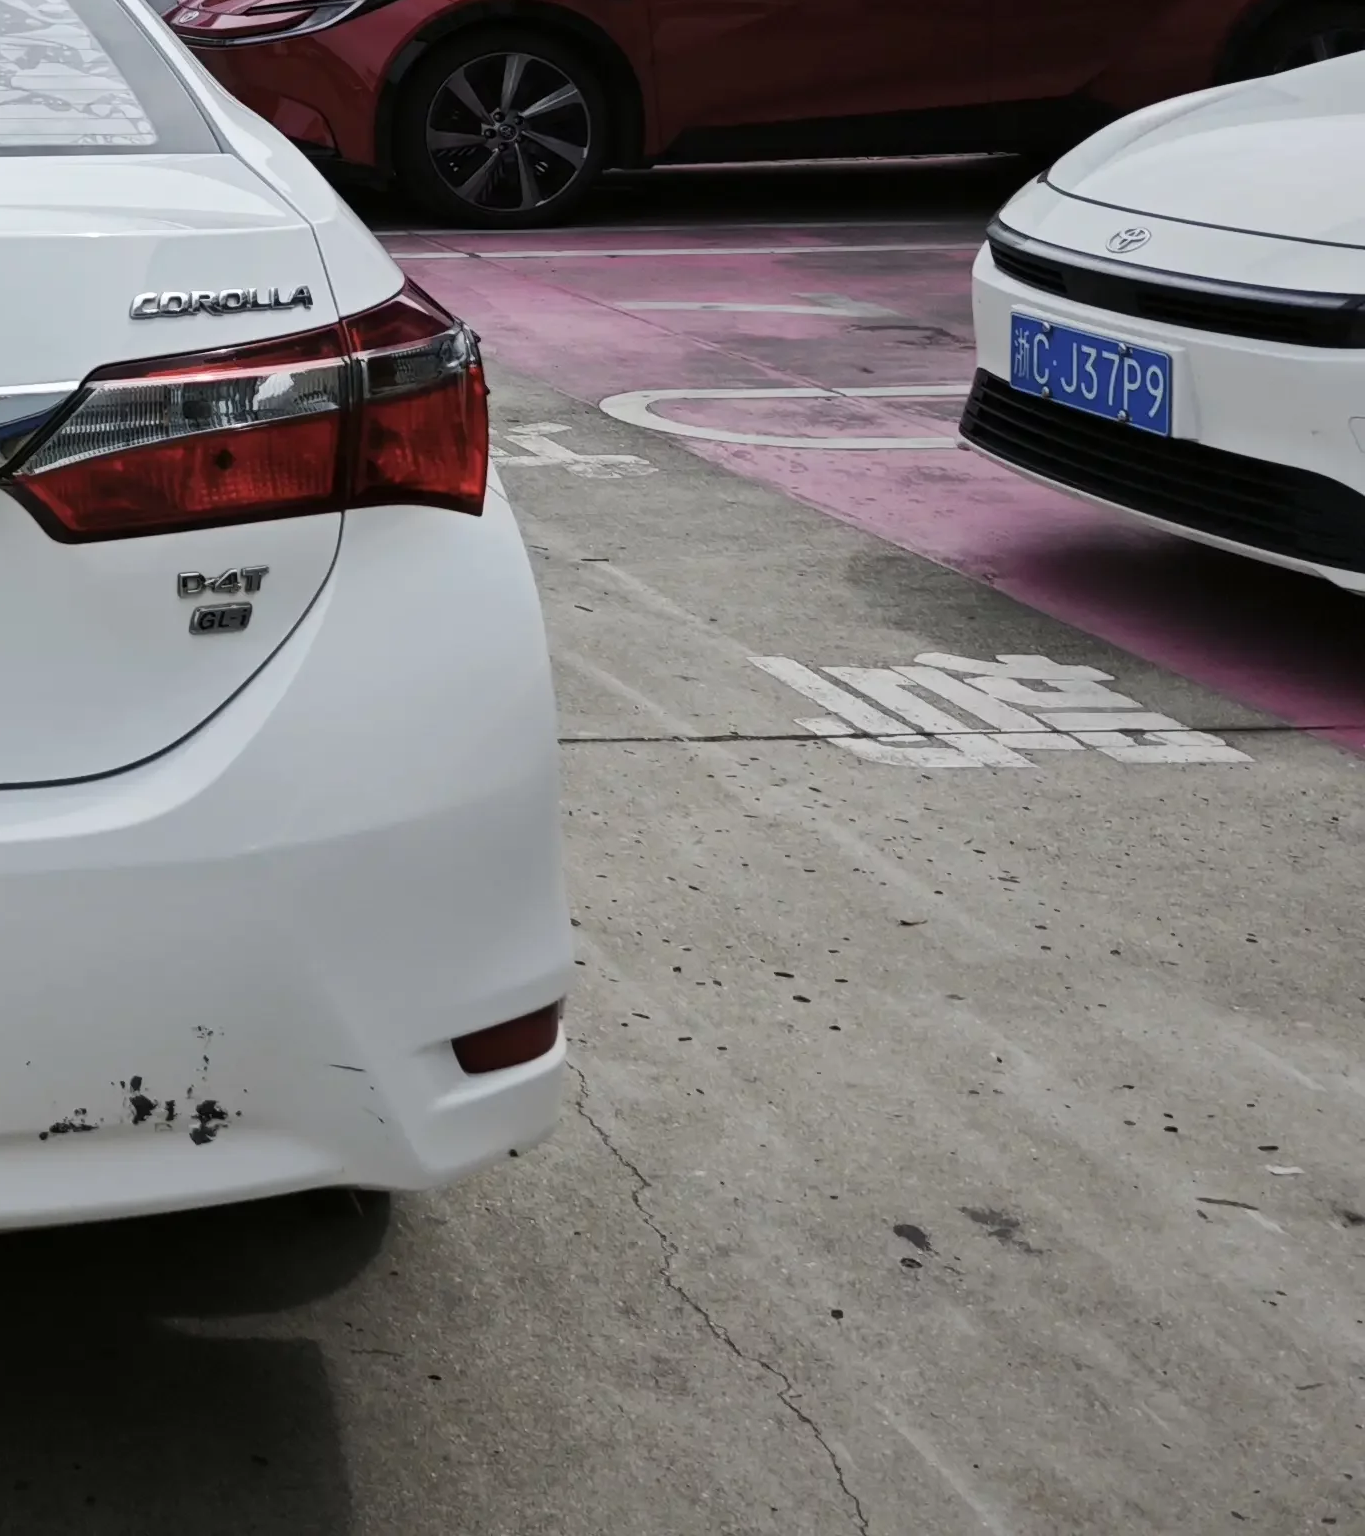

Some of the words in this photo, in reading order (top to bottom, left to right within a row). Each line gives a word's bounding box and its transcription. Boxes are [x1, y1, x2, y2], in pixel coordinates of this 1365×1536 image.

[129, 285, 314, 320] COROLLA
[177, 565, 270, 599] D-4T
[196, 607, 250, 631] GL-i
